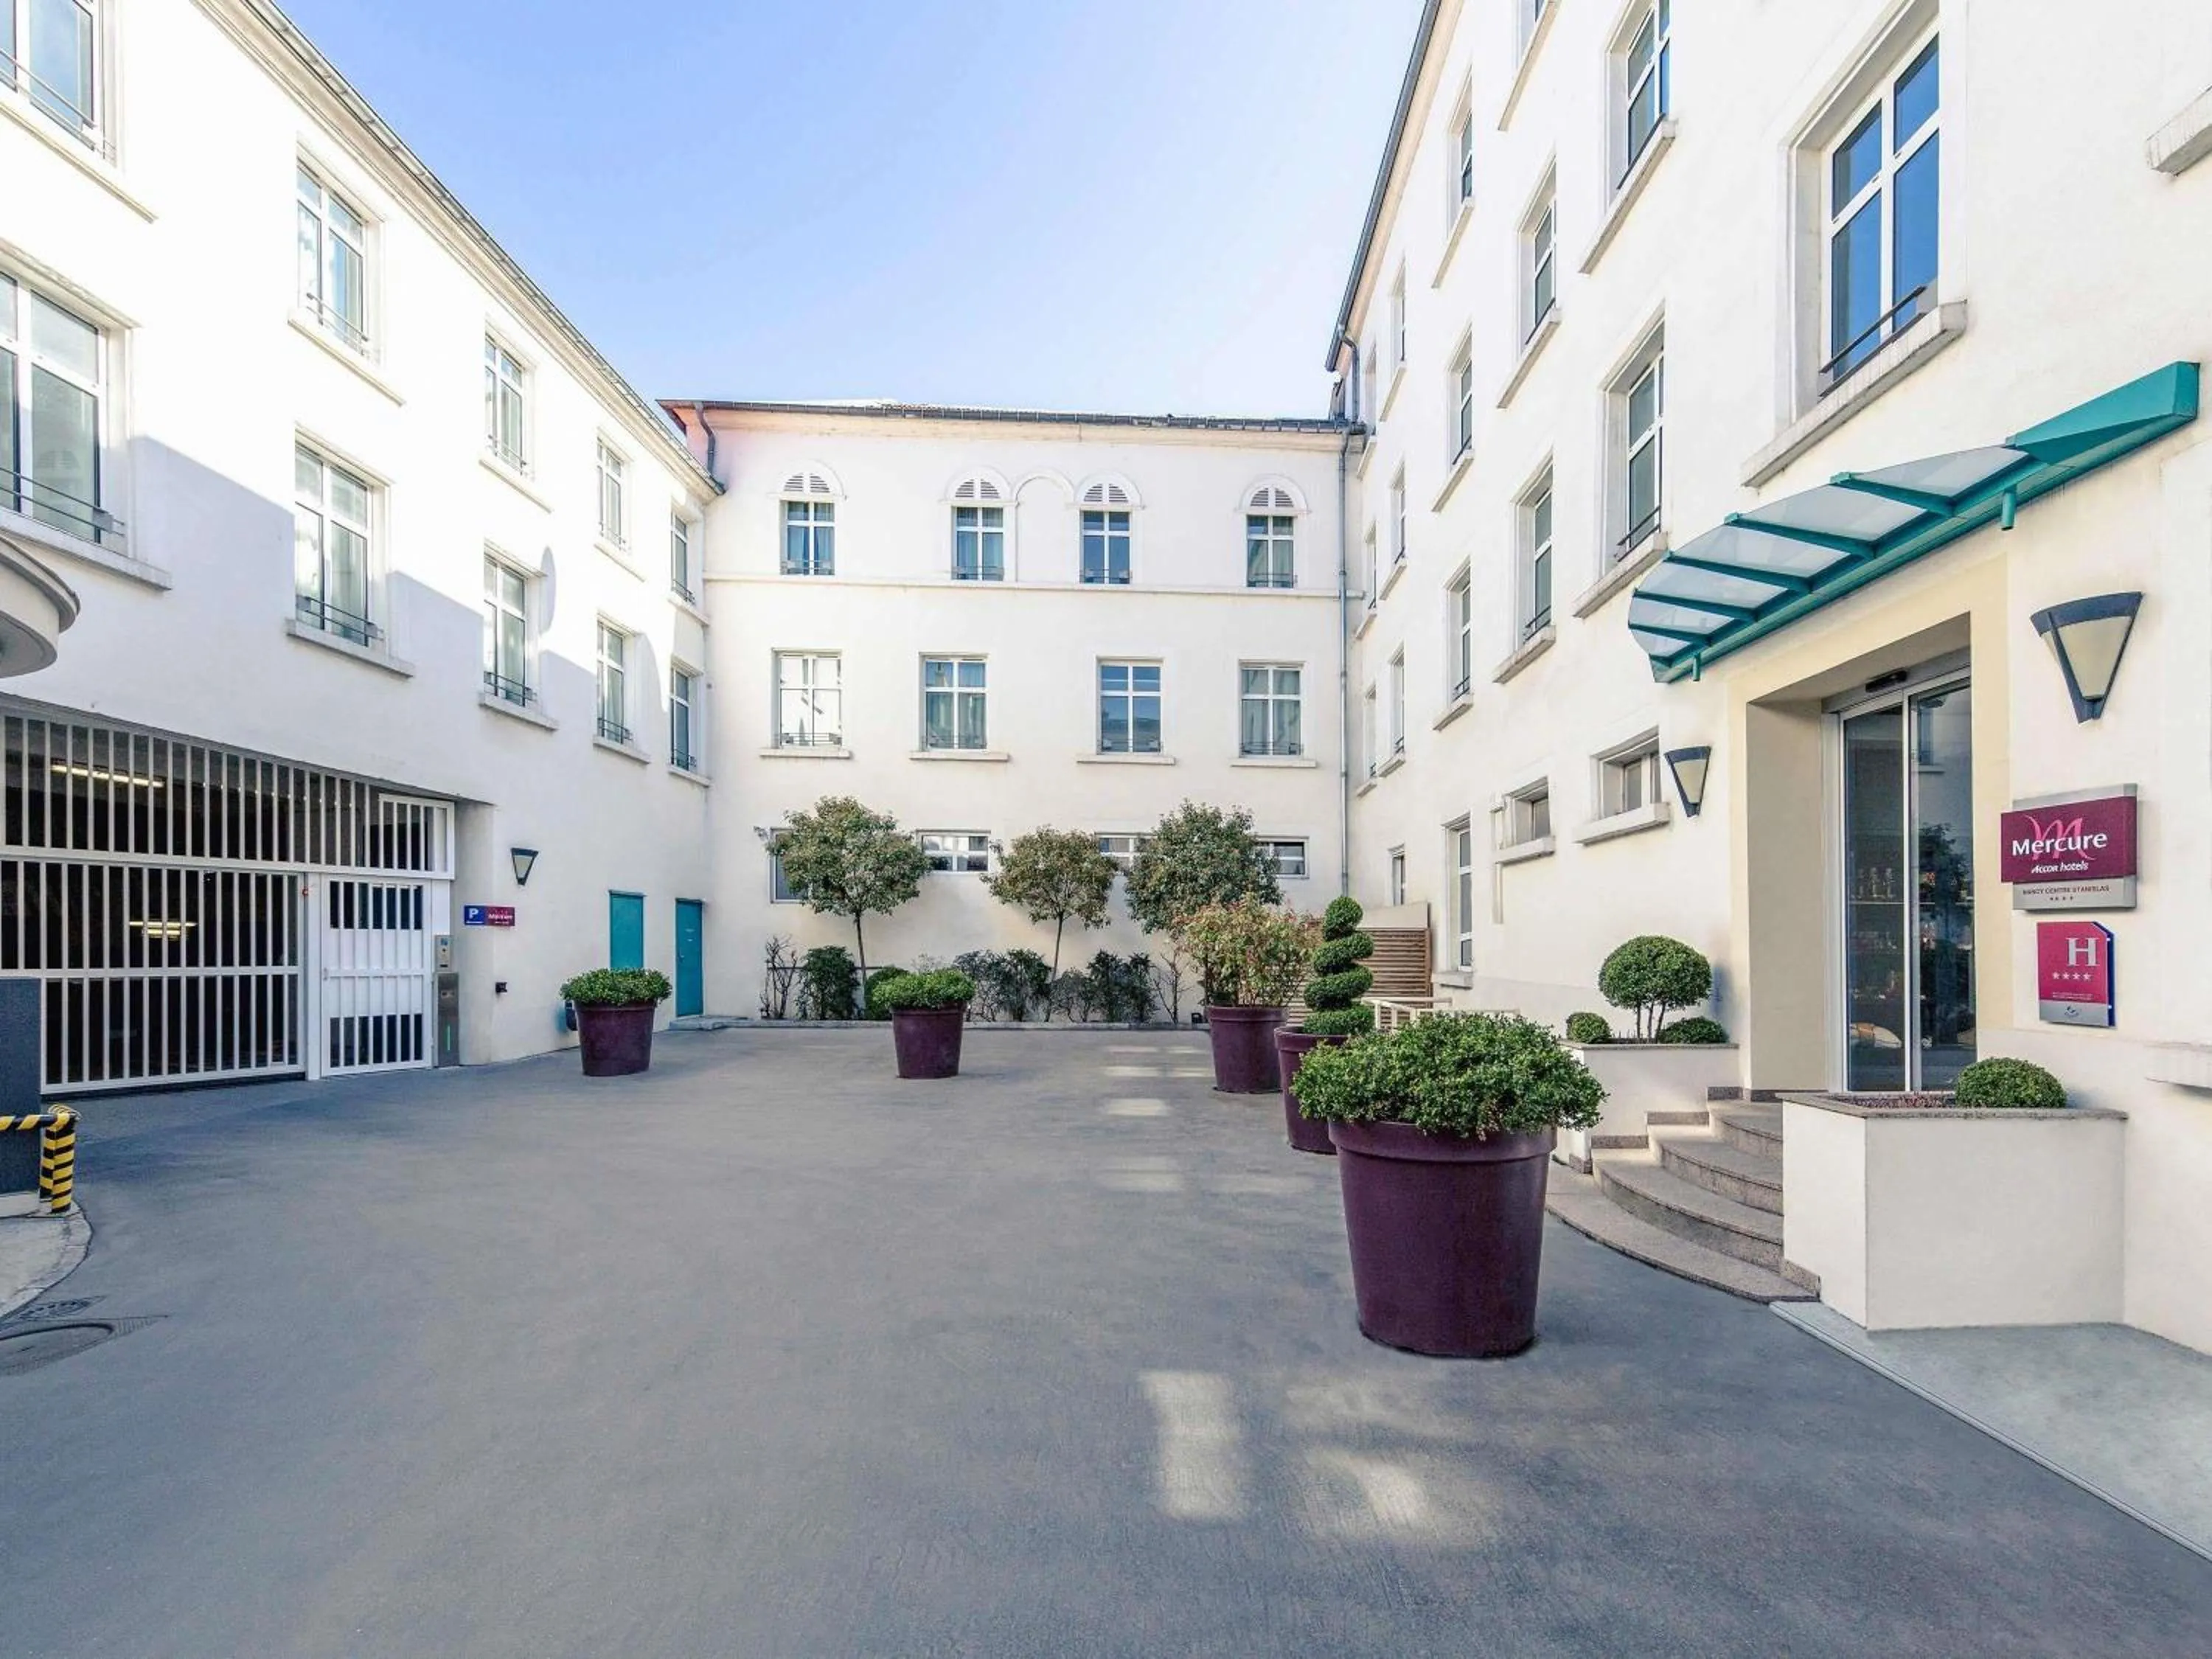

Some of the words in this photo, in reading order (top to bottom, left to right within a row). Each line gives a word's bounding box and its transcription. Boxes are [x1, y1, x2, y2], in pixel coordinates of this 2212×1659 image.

[2012, 832, 2109, 856] Mercure
[2059, 860, 2089, 872] hotels
[2045, 886, 2070, 894] CENTRE
[469, 908, 479, 919] P
[2066, 937, 2101, 967] H
